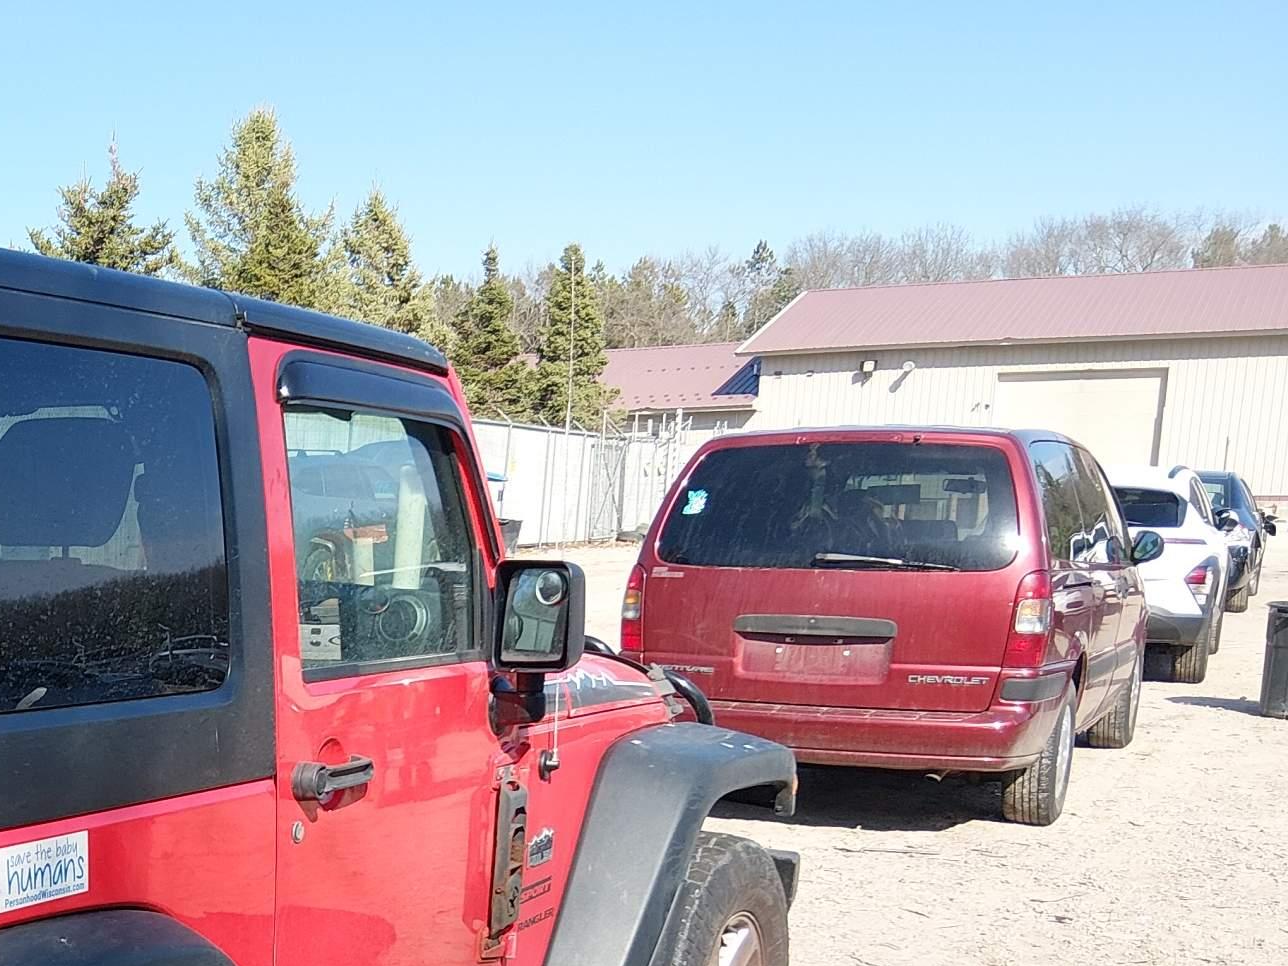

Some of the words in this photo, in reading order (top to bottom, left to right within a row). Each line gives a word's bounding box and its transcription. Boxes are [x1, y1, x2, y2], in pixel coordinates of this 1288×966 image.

[908, 675, 990, 685] CHEVROLET
[10, 852, 31, 867] save
[35, 843, 52, 861] the
[55, 837, 78, 858] baby
[6, 856, 84, 895] humans
